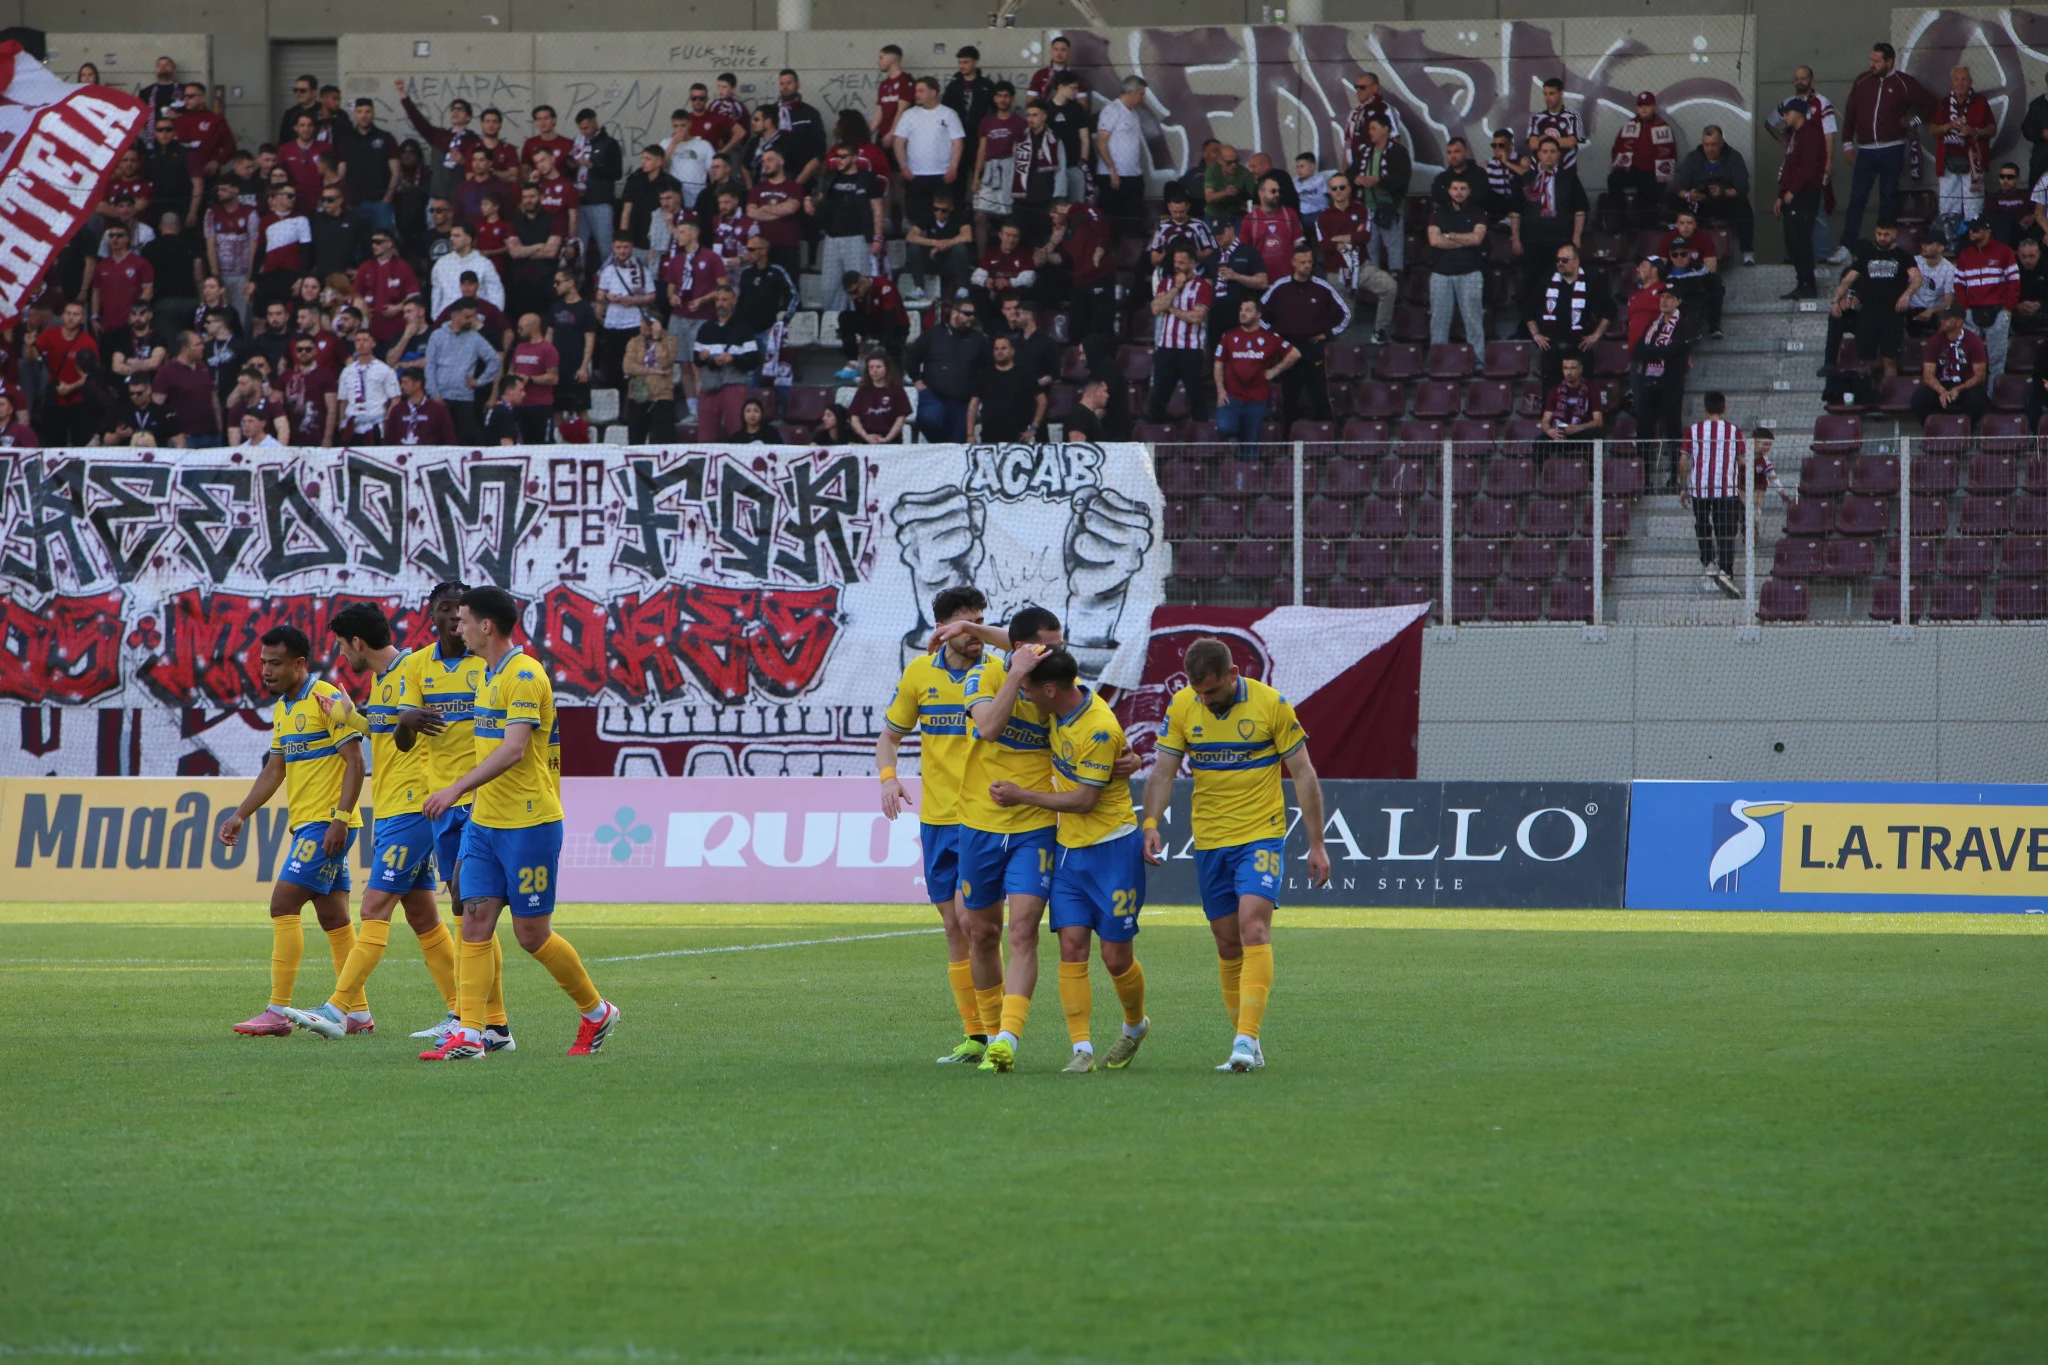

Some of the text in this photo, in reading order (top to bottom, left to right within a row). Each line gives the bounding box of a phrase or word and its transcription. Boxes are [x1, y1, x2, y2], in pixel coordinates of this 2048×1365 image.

[670, 46, 716, 63] FUCK
[0, 94, 140, 318] ΗΤΕΙΑ
[964, 444, 1104, 501] ACAB
[0, 448, 546, 590] REEDOM
[612, 451, 868, 585] FOR
[1194, 748, 1255, 765] novibet
[664, 811, 924, 868] RUB
[1143, 805, 1588, 862] VALLO
[1800, 824, 1883, 870] L.A.
[291, 838, 317, 864] 19
[382, 844, 409, 870] 41
[1254, 849, 1280, 877] 35
[518, 865, 548, 894] 28
[1288, 878, 1464, 890] LIAN STYLE
[1111, 888, 1138, 917] 22
